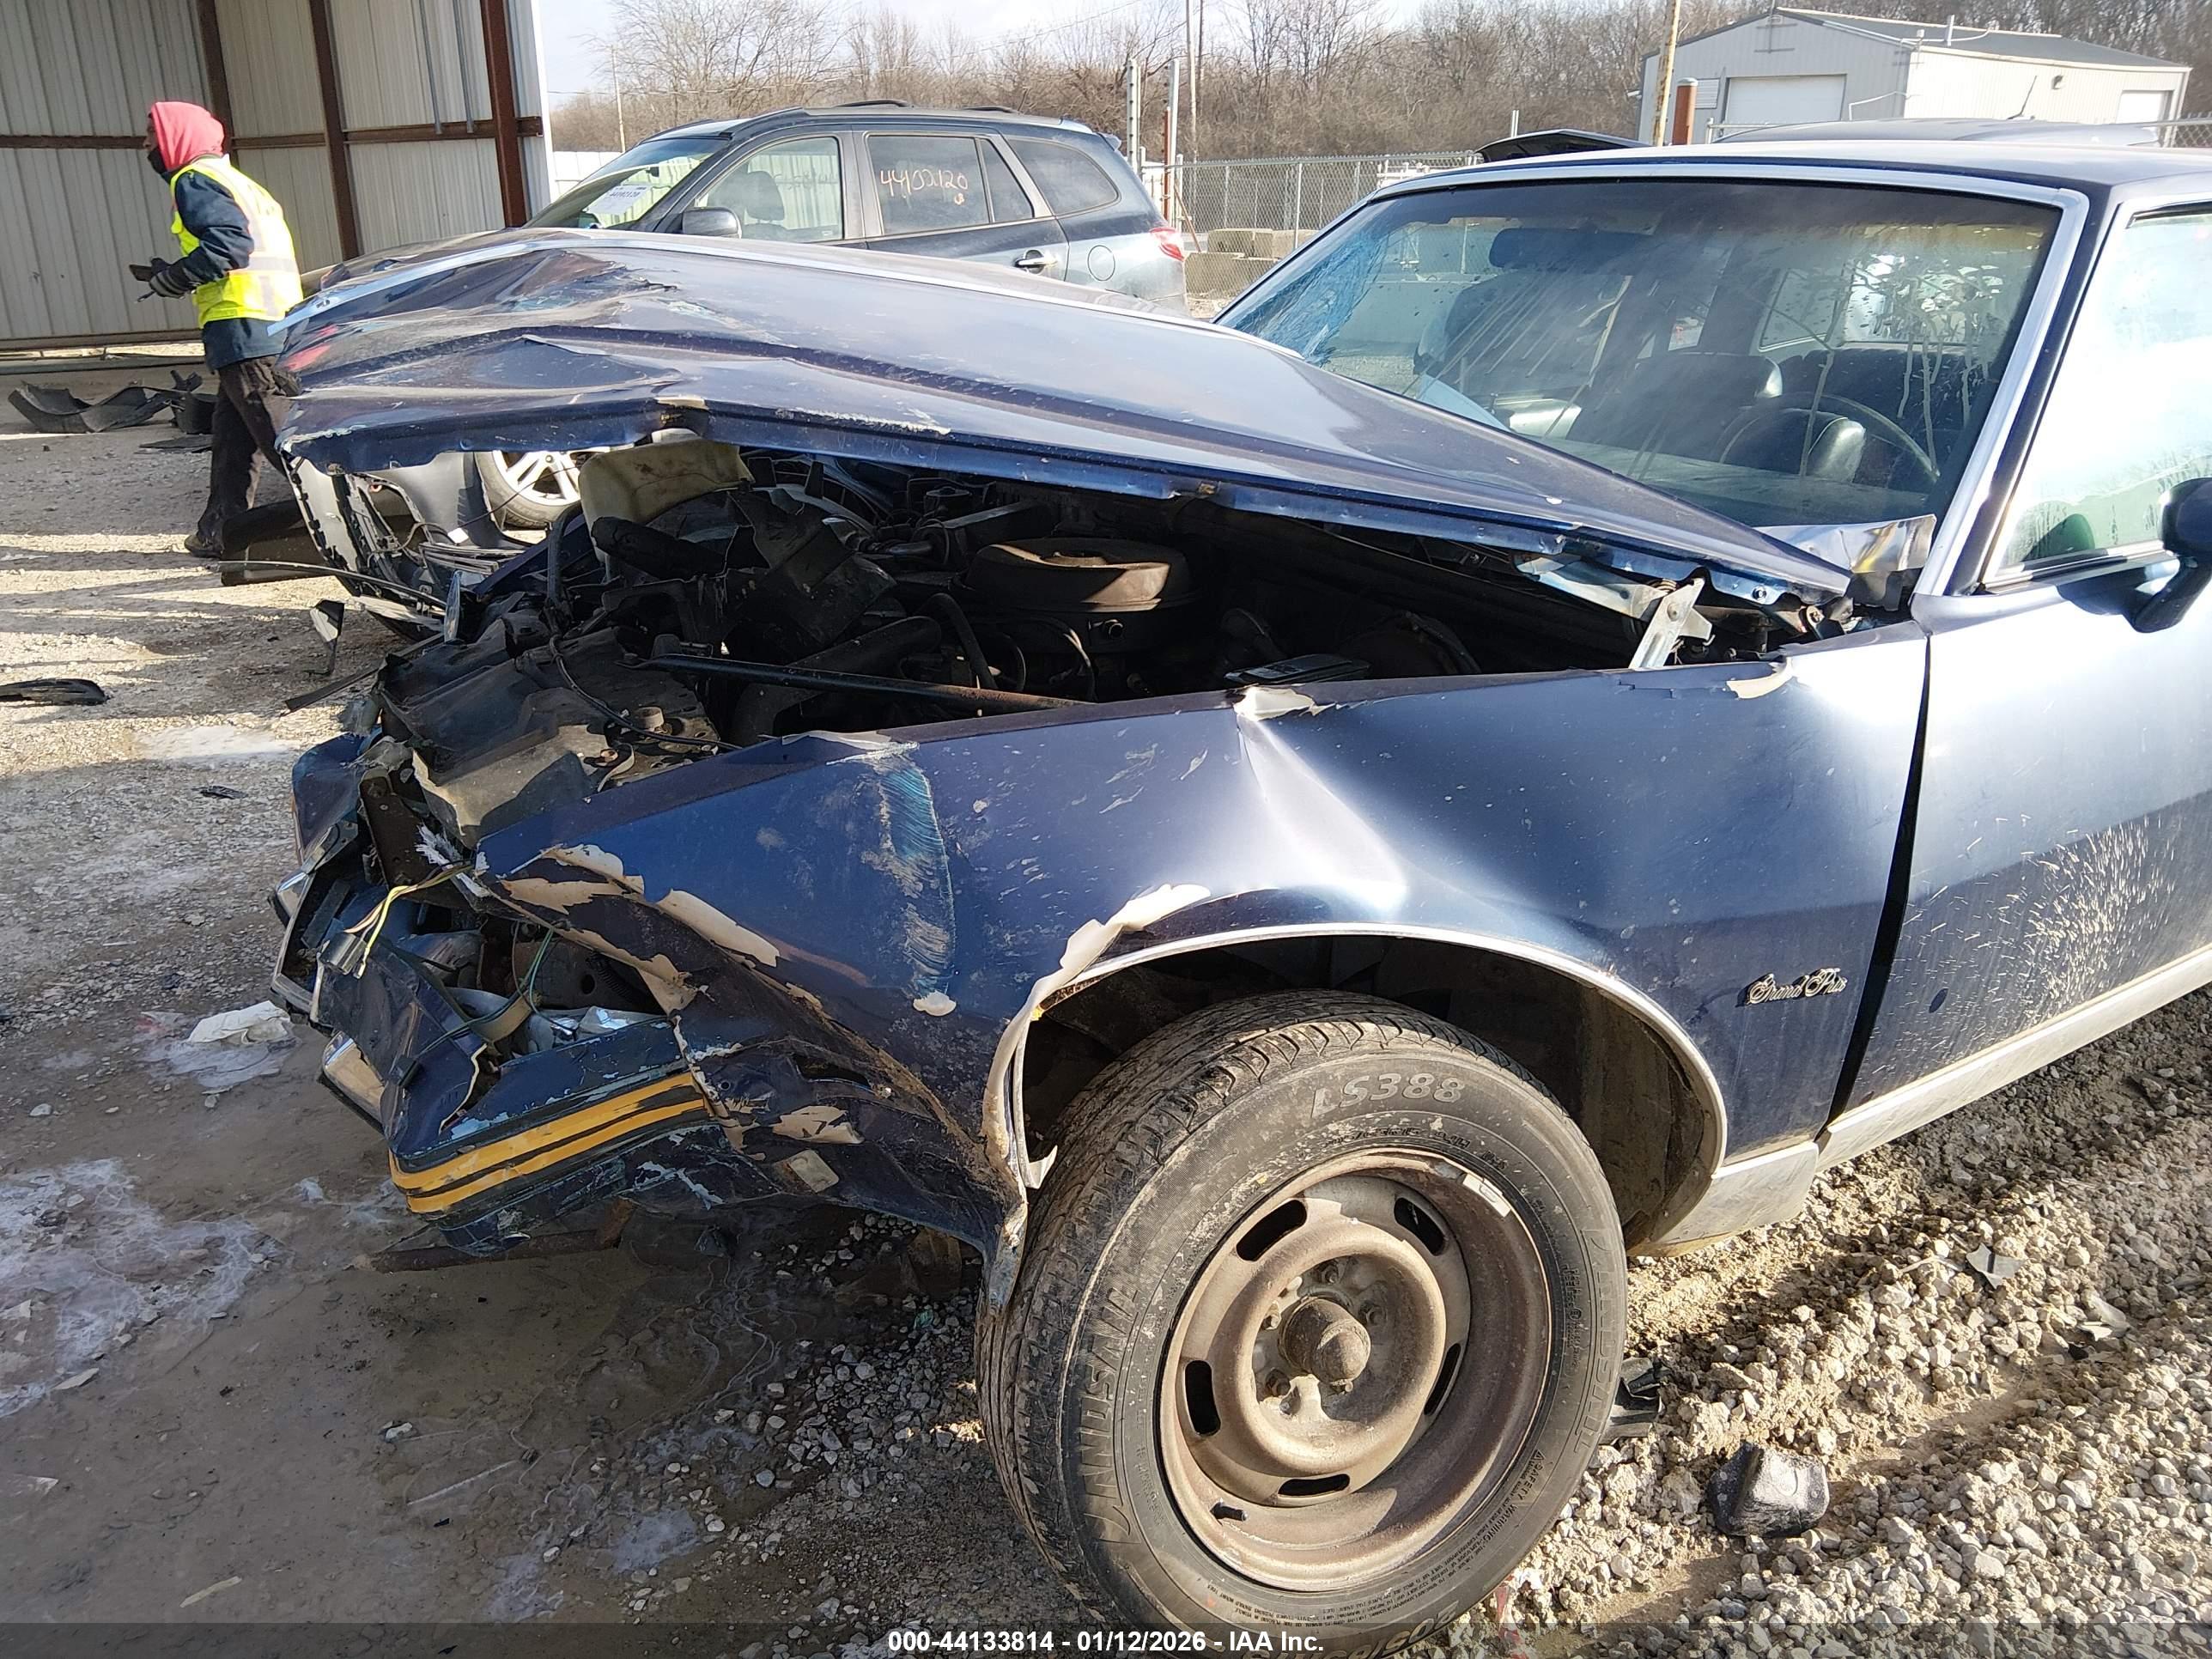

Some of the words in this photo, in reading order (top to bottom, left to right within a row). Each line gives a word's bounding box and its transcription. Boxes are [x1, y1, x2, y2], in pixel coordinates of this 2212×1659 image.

[880, 169, 968, 197] 44102120
[1746, 973, 1809, 1005] Grand
[1805, 968, 1848, 997] Prix
[1310, 1073, 1465, 1118] LS388
